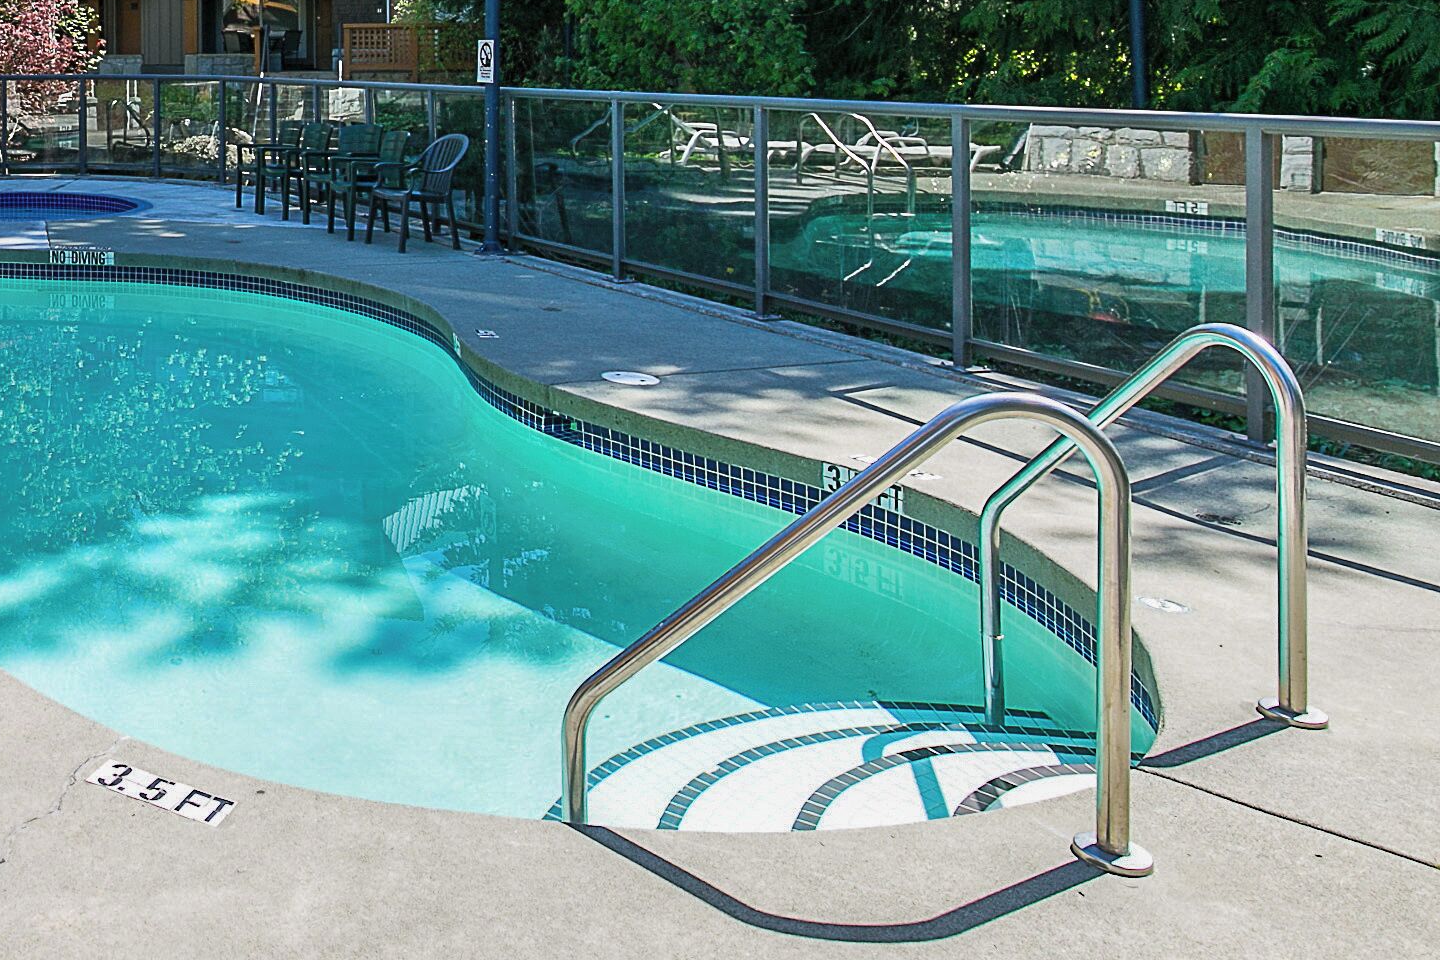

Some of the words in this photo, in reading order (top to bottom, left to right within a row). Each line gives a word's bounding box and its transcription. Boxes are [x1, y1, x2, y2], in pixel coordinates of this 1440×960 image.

[52, 251, 65, 264] NO
[72, 251, 105, 265] DIVING
[174, 789, 235, 822] FT
